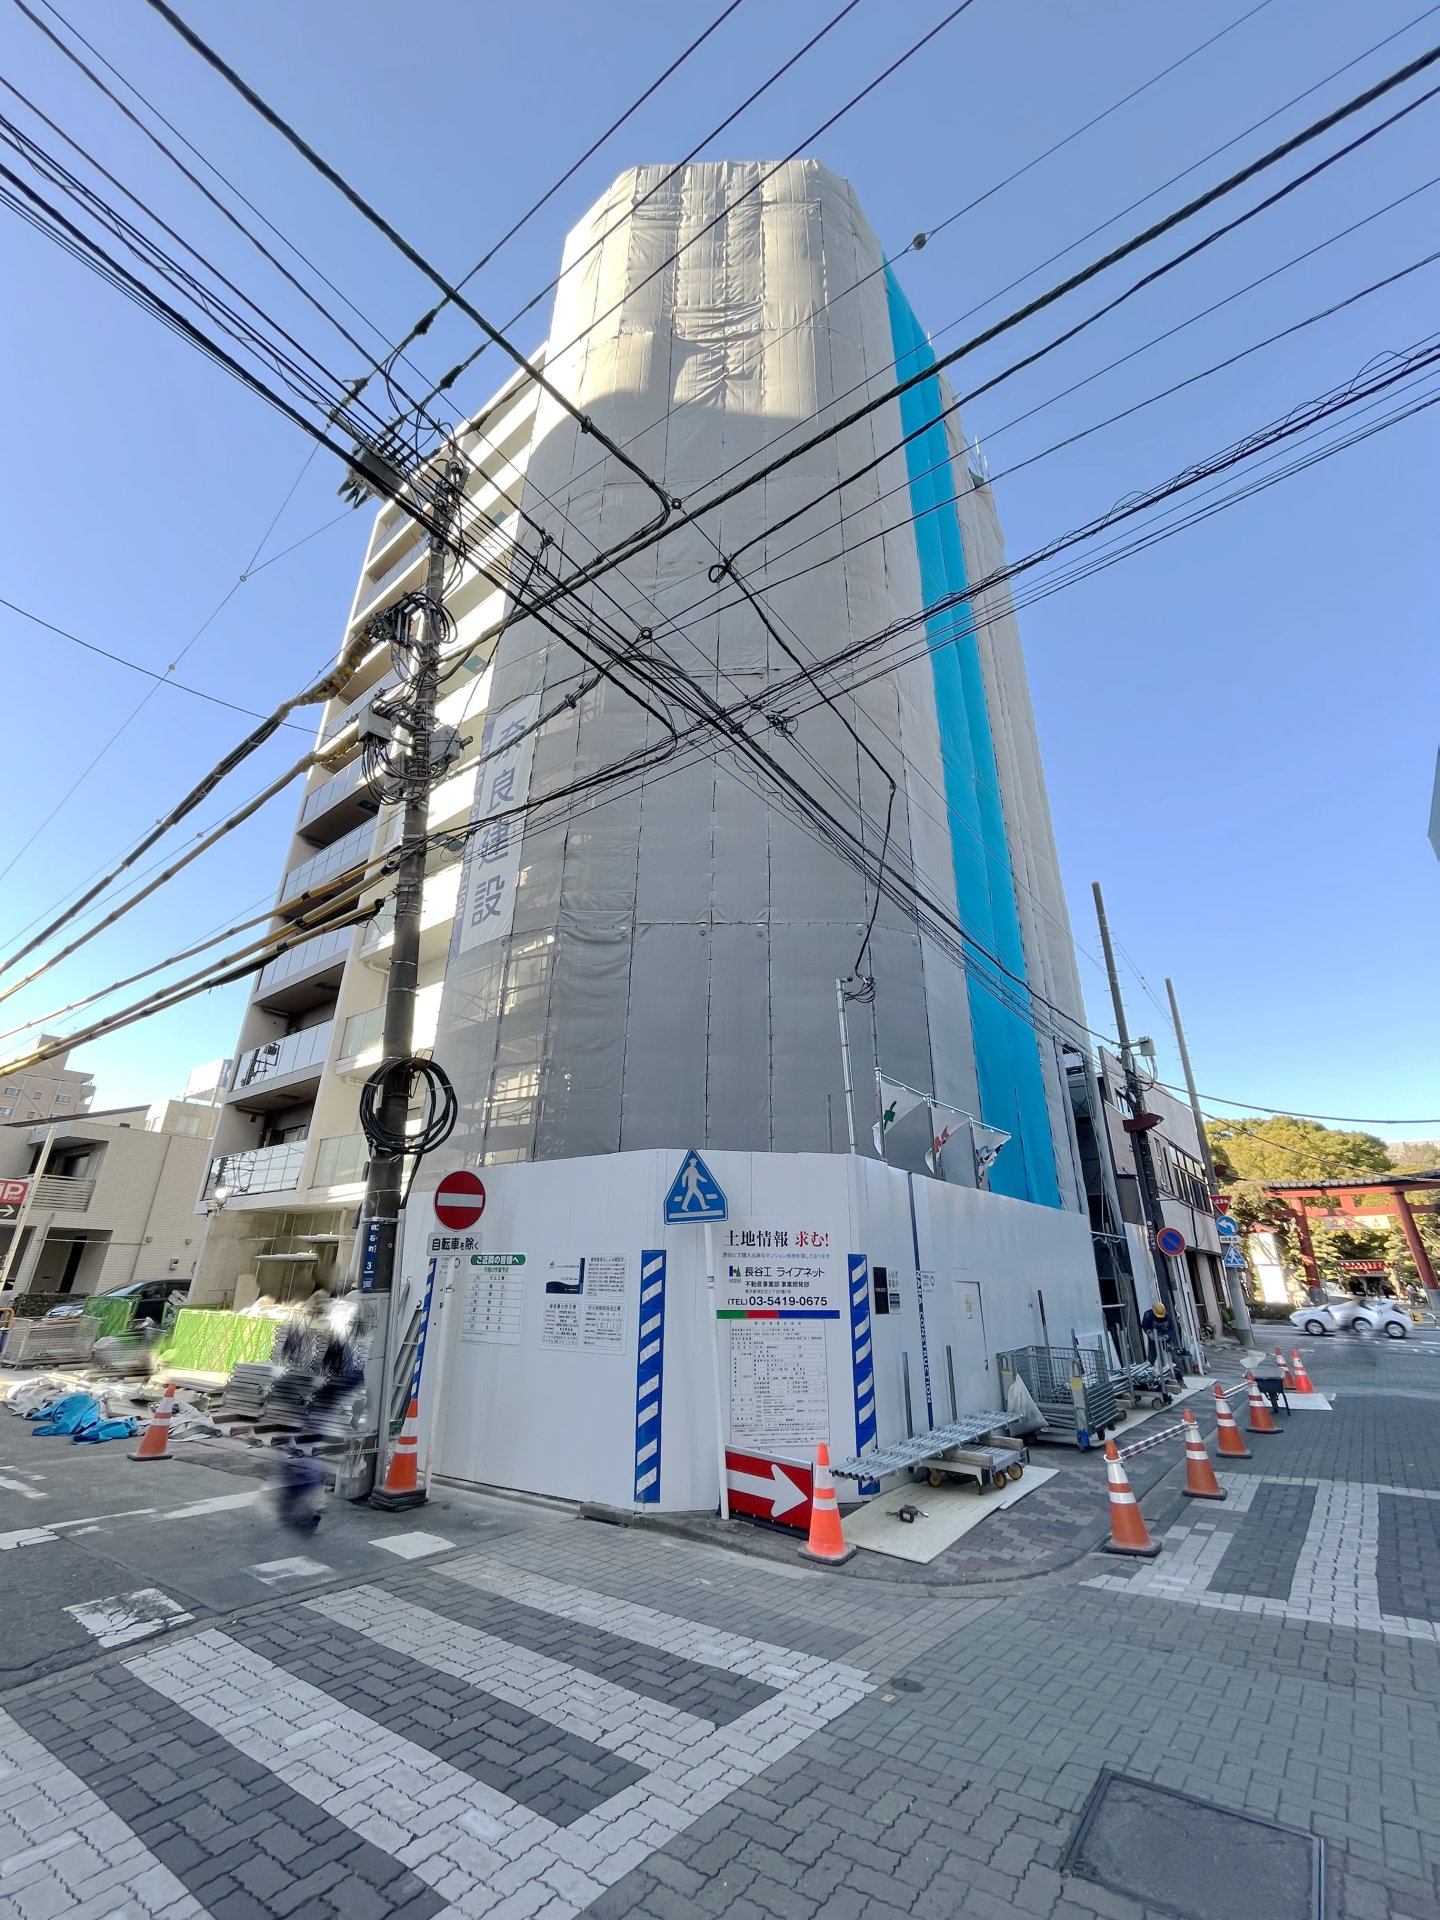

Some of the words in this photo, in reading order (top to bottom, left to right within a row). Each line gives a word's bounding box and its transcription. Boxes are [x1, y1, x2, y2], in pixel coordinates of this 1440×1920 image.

[432, 1237, 480, 1251] 自転車を除く
[724, 1230, 788, 1247] 土地情報
[795, 1231, 829, 1248] 求む!
[745, 1267, 772, 1278] 長谷工
[776, 1267, 825, 1278] ライブネット
[749, 1296, 828, 1306] 03-5419-0675
[915, 1270, 923, 1304] NARA
[919, 1312, 932, 1403] CONSTRUCTION
